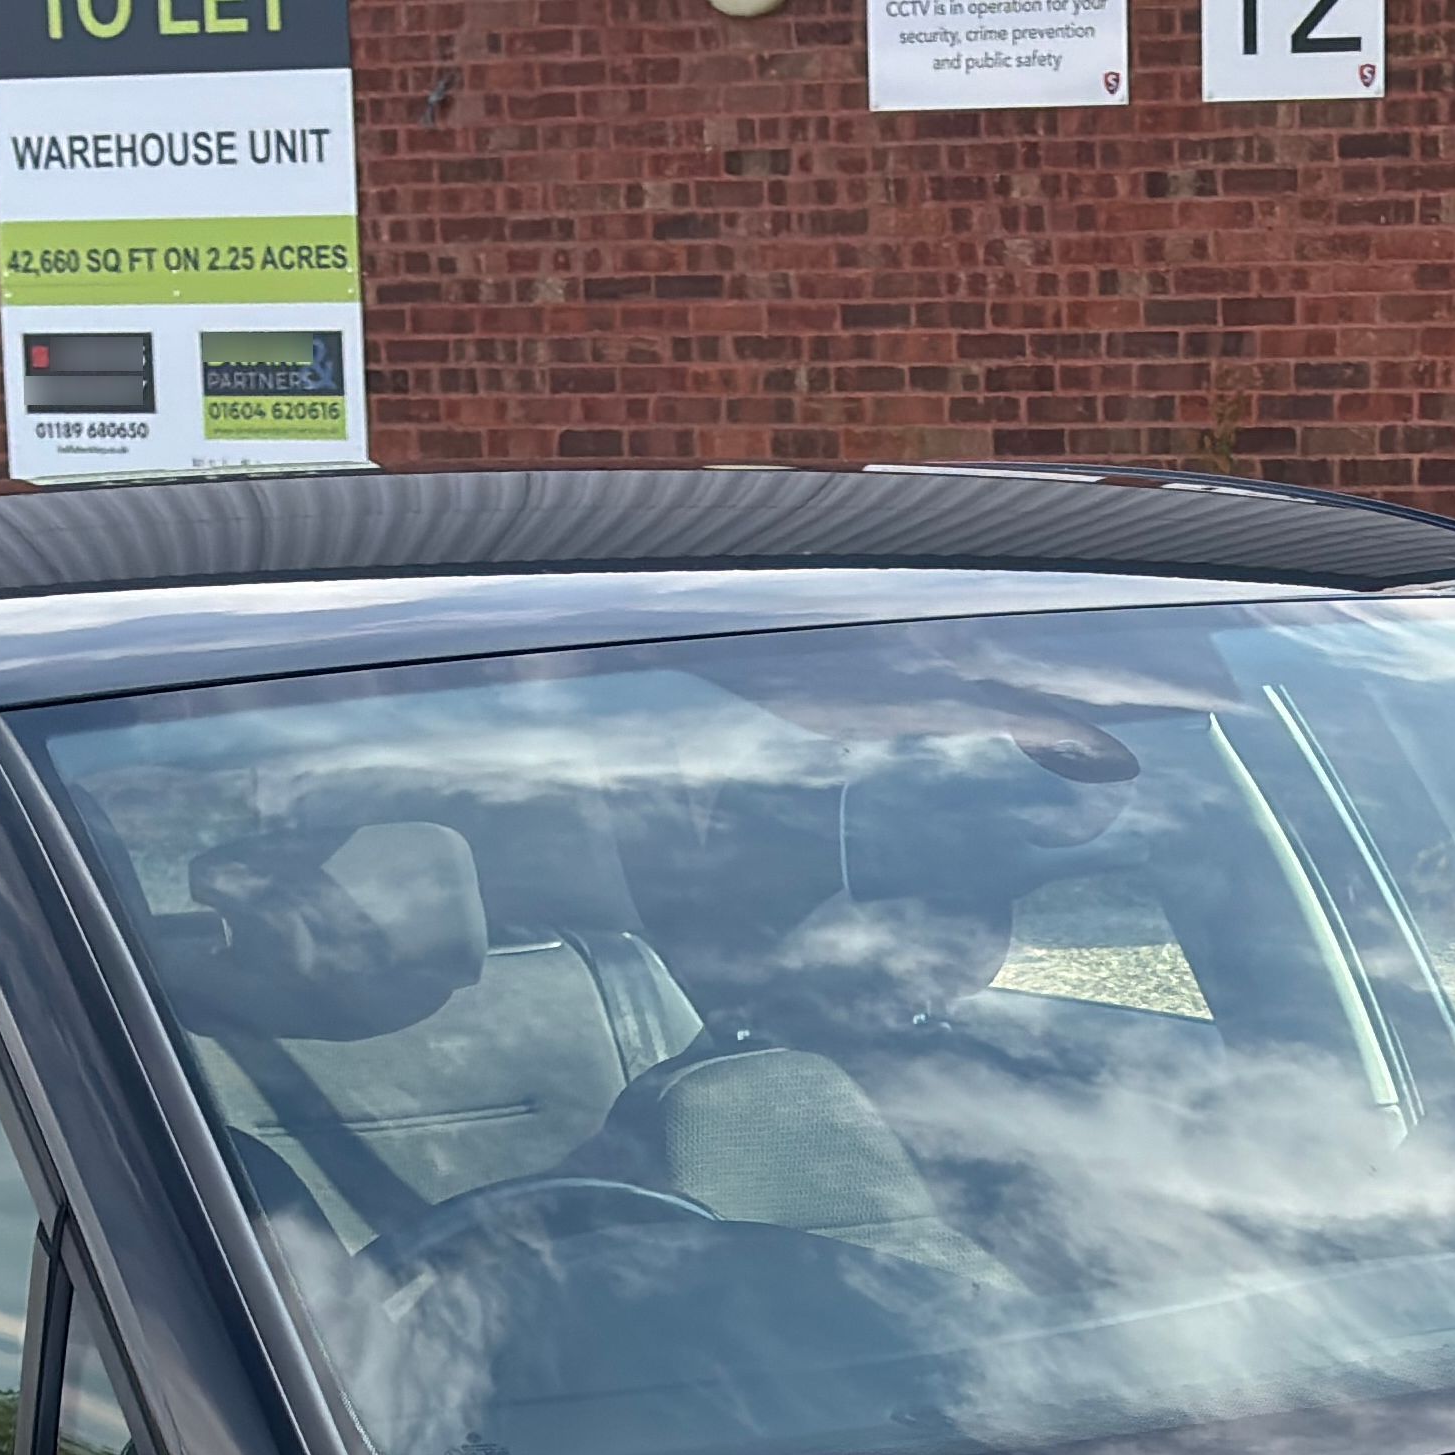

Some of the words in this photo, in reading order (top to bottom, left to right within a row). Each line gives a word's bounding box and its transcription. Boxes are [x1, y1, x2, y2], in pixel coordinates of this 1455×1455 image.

[886, 1, 930, 17] CCTV
[934, 0, 946, 15] is
[950, 0, 964, 15] in
[968, 0, 1042, 19] operation
[900, 27, 961, 47] security,
[966, 26, 1008, 42] crime
[1012, 23, 1095, 45] prevention
[933, 53, 962, 70] and
[965, 51, 1012, 74] public
[1015, 50, 1062, 73] safety
[12, 131, 238, 170] WAREHOUSE
[249, 128, 330, 164] UNIT
[6, 249, 80, 277] 42,660
[86, 248, 122, 273] SQ
[128, 247, 157, 271] FT
[163, 247, 200, 271] ON
[207, 246, 254, 271] 2.25
[260, 244, 348, 270] ACRES
[207, 371, 315, 390] PARTNERS
[208, 402, 266, 420] 01604
[271, 402, 341, 420] 620616
